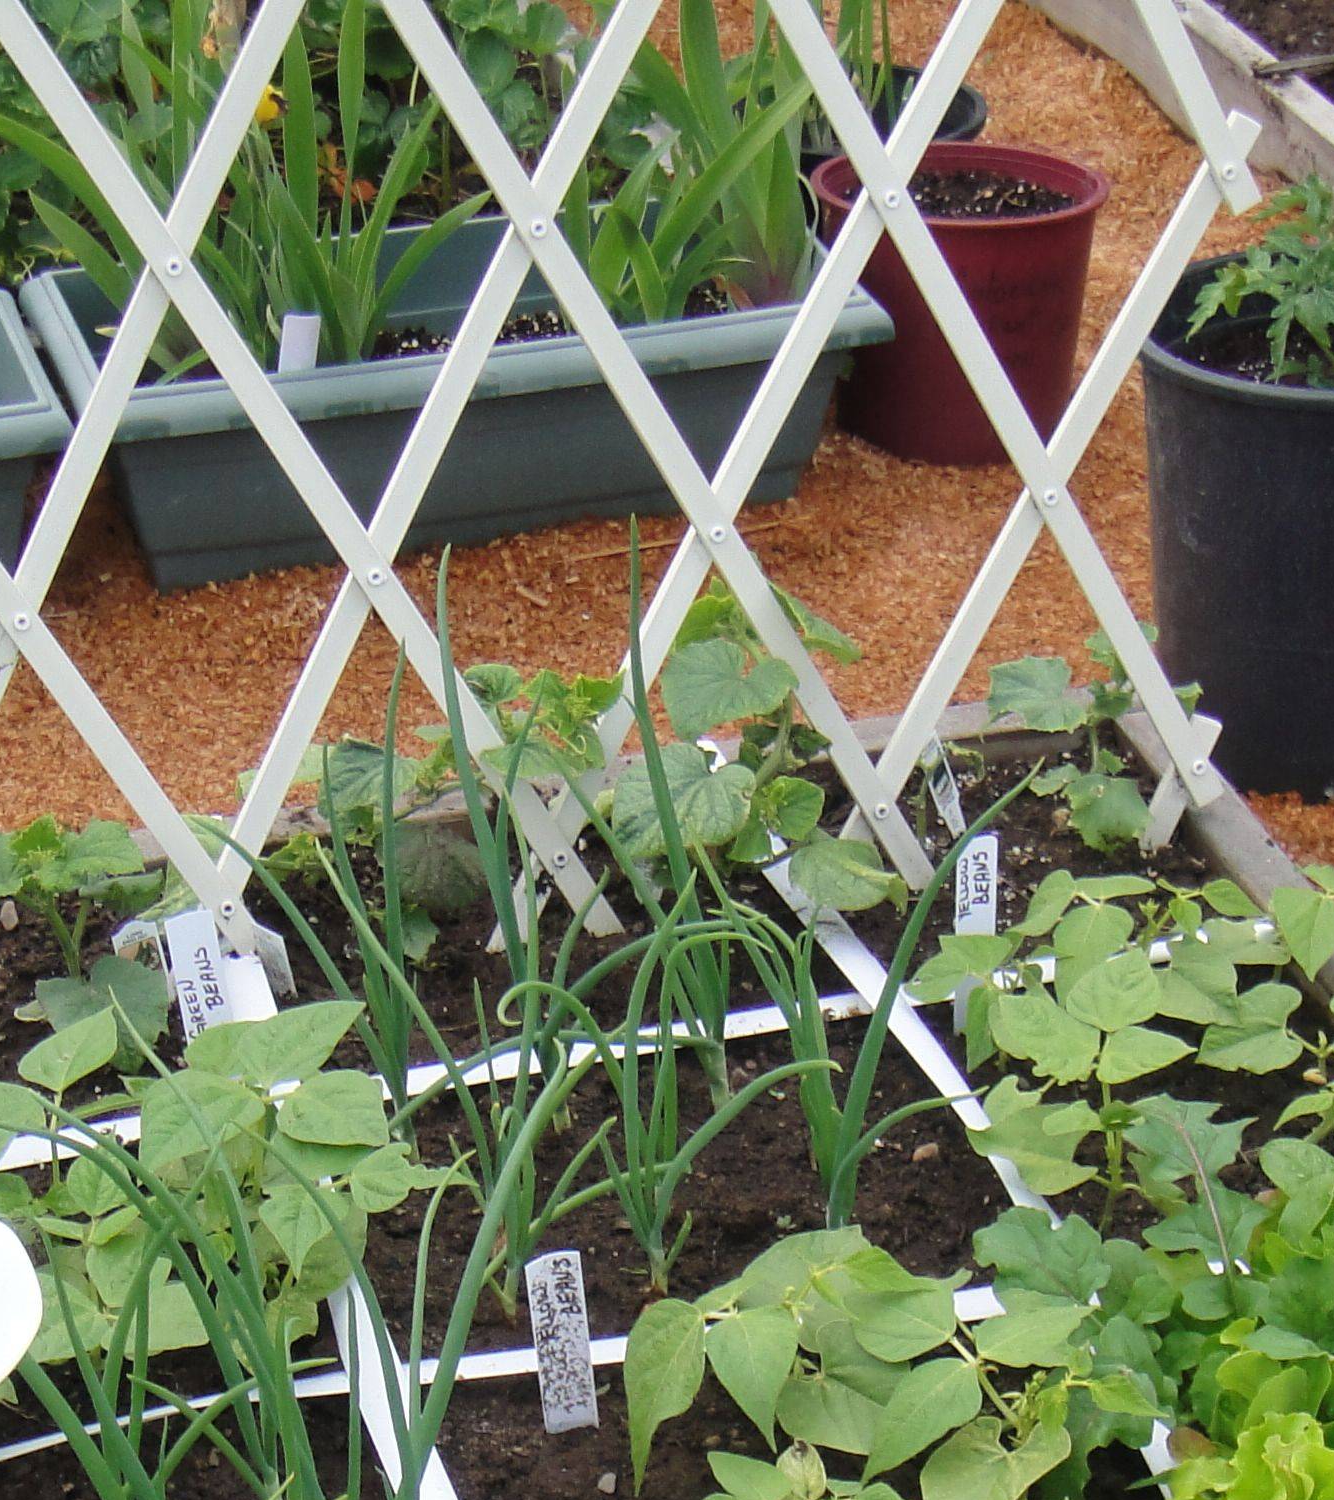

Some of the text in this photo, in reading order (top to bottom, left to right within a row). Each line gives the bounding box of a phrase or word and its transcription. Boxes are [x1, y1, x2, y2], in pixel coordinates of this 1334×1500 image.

[958, 857, 971, 921] YELLOW
[971, 851, 991, 905] BEANS
[177, 979, 208, 1039] GREEN
[194, 947, 225, 1011] BEANS
[551, 1257, 582, 1314] BEANS
